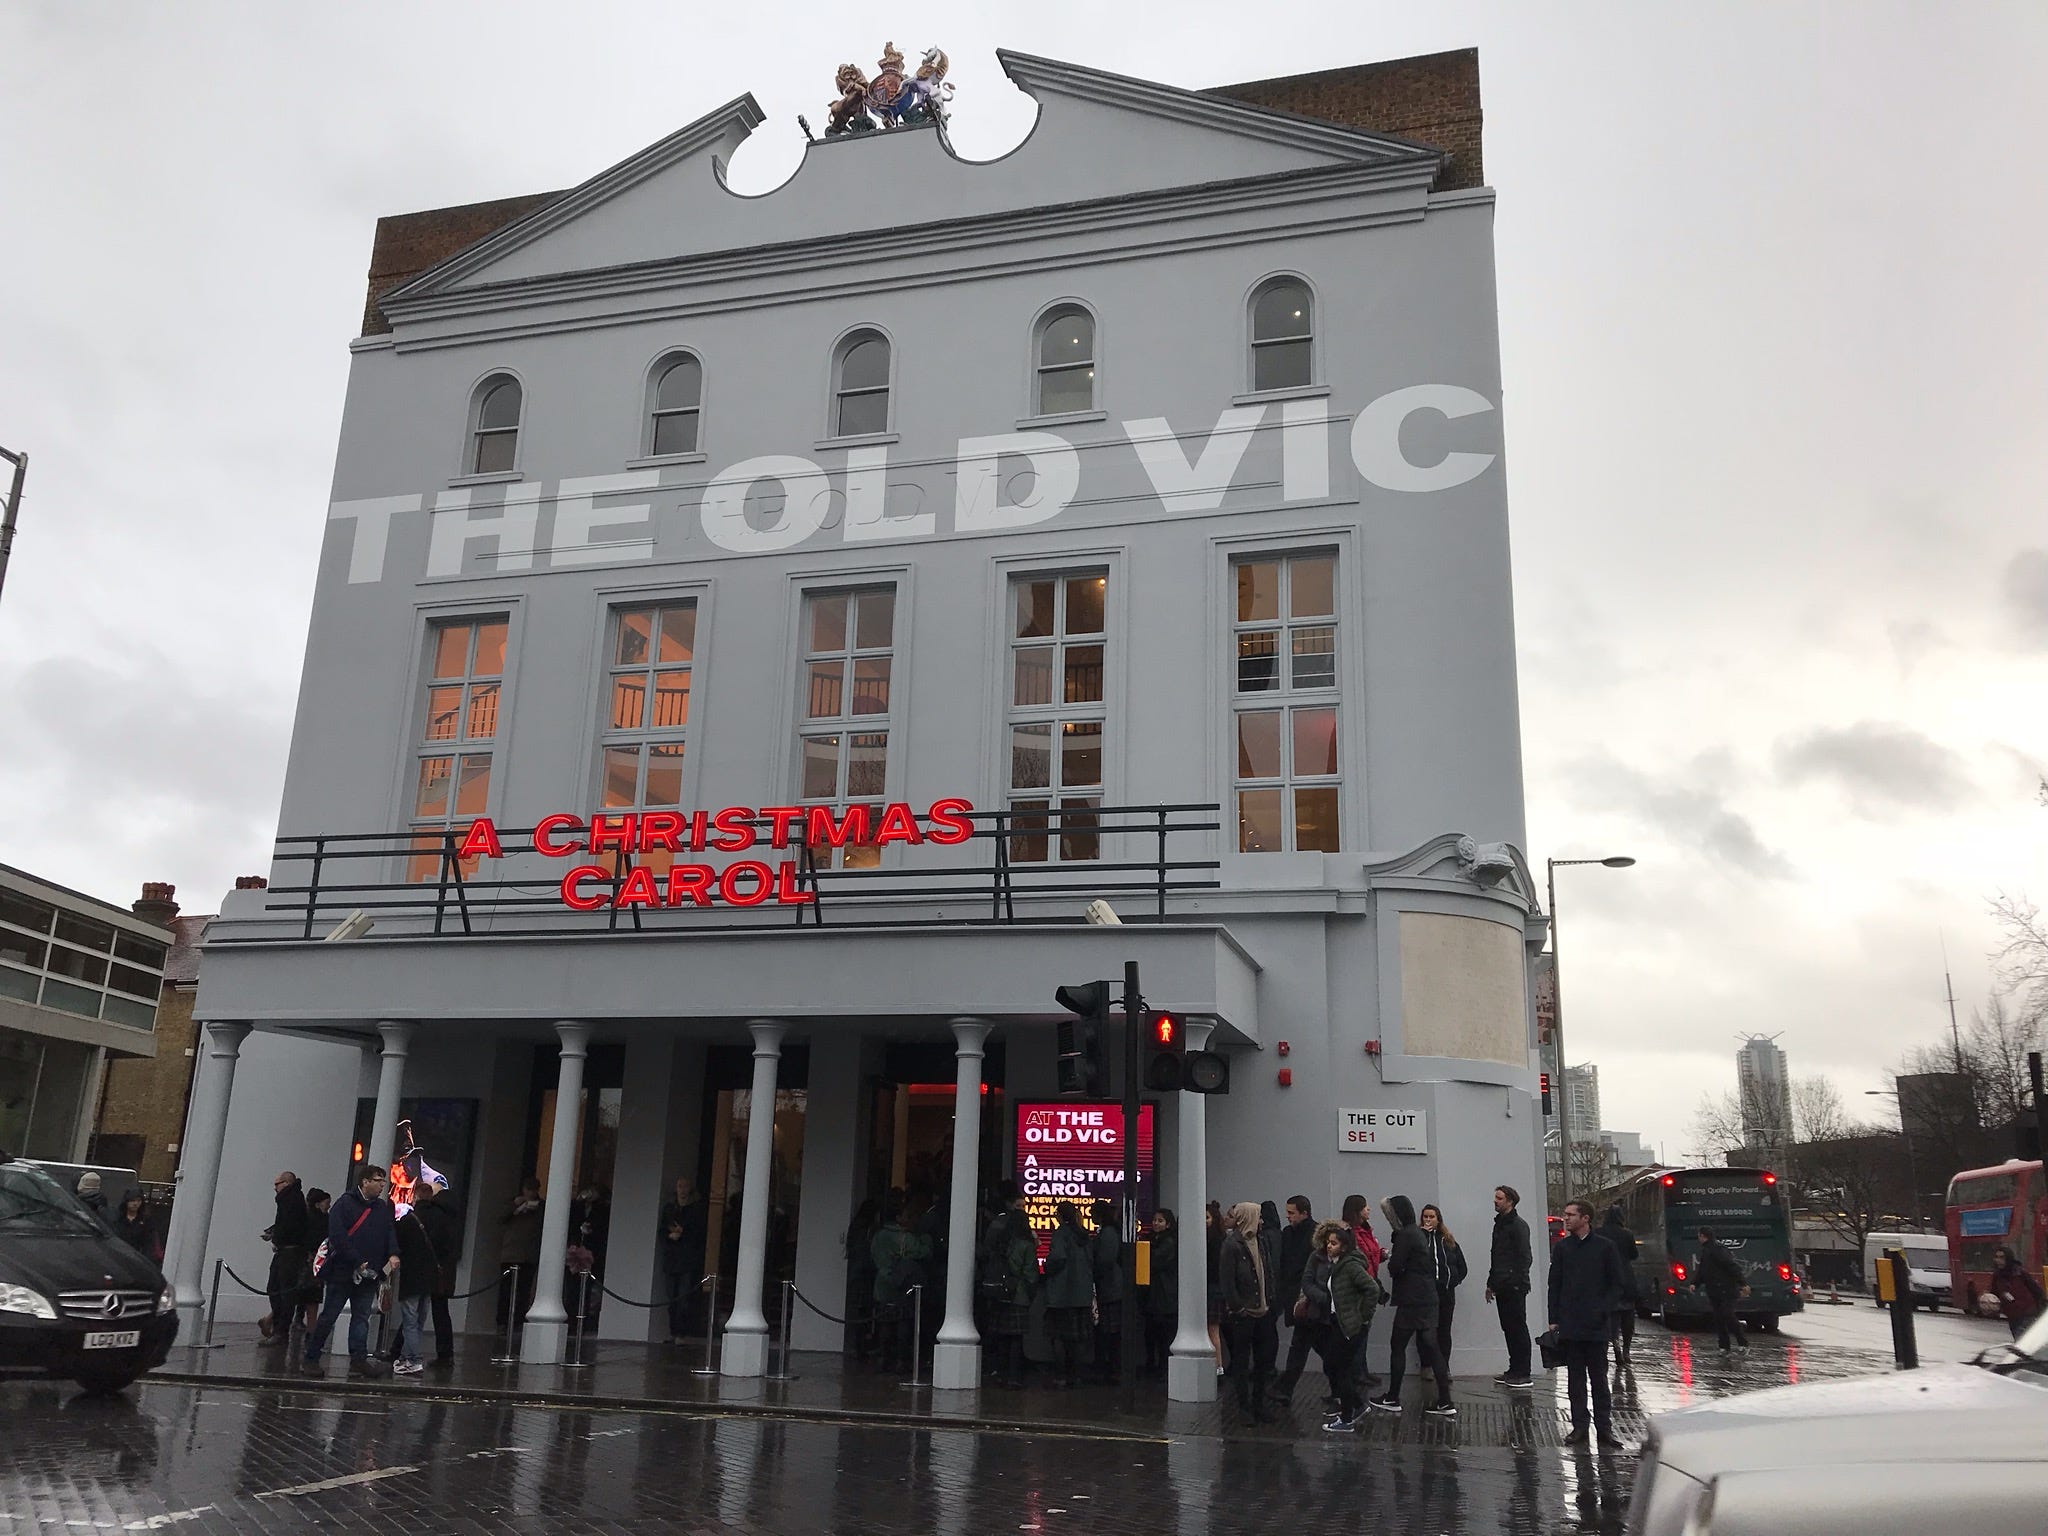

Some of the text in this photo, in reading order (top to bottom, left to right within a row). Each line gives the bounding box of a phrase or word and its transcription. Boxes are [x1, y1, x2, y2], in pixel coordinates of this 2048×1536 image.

[329, 383, 1496, 585] THE OLD VIC
[457, 798, 974, 860] A CHRISTMAS
[561, 861, 816, 911] CAROL
[1025, 1111, 1104, 1126] AT THE
[1348, 1114, 1415, 1126] THE CUT
[1025, 1128, 1116, 1143] OLD VIC
[1348, 1131, 1375, 1142] SE1
[1024, 1155, 1038, 1166] A
[1024, 1183, 1091, 1196] CAROL
[1683, 1187, 1706, 1196] Driving
[1708, 1186, 1730, 1195] Quality
